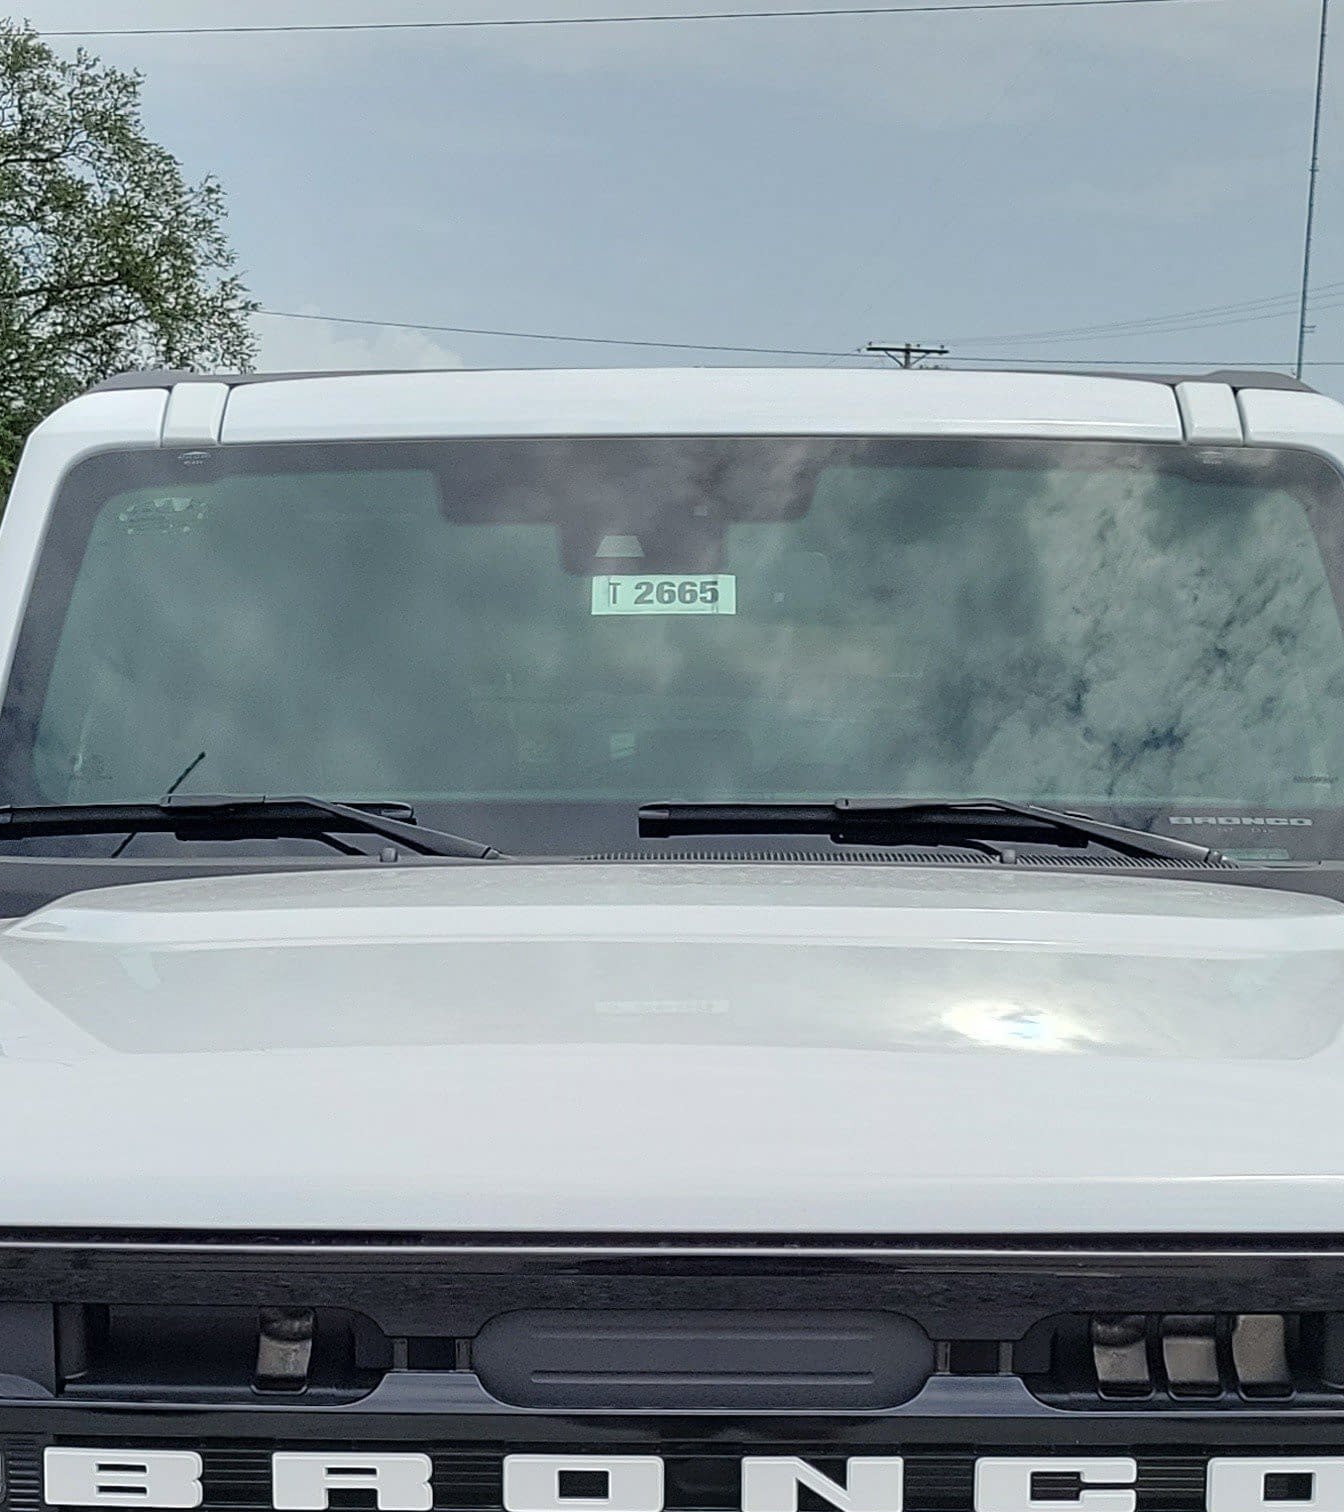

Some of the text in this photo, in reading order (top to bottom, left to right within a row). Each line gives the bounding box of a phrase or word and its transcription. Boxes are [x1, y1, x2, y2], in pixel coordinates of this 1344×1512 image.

[608, 581, 719, 605] T 2665
[1169, 816, 1314, 826] BRONCO
